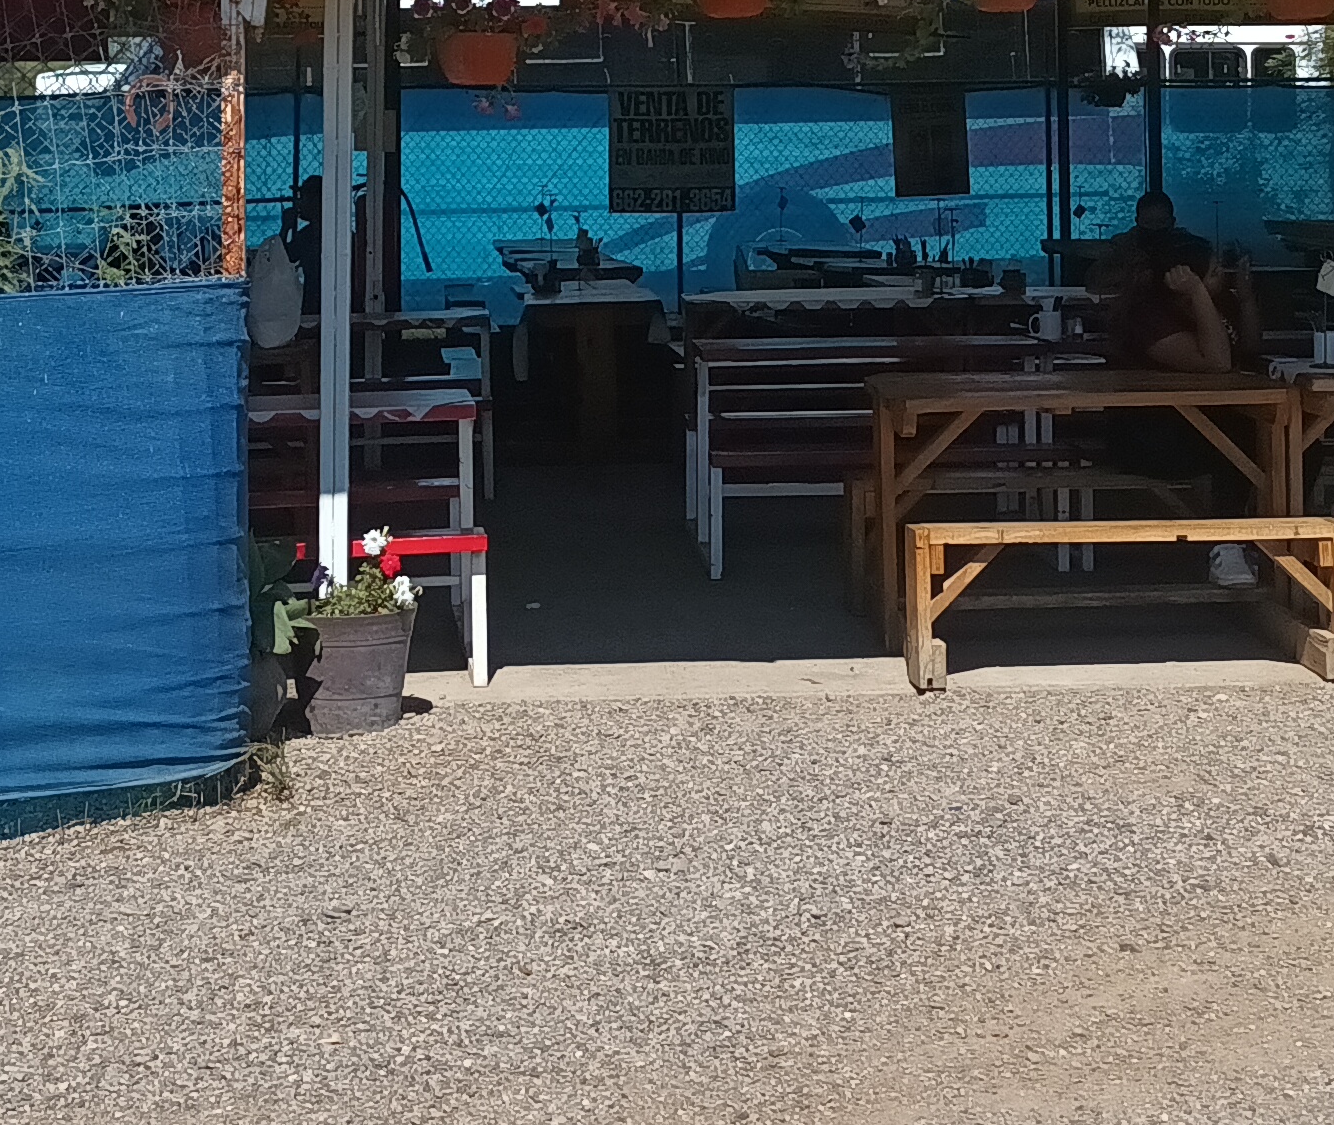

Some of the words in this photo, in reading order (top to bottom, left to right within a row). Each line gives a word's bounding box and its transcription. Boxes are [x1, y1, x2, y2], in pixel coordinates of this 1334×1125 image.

[617, 91, 689, 117] VENTA
[696, 90, 725, 116] DE
[613, 117, 730, 144] TERRENOS
